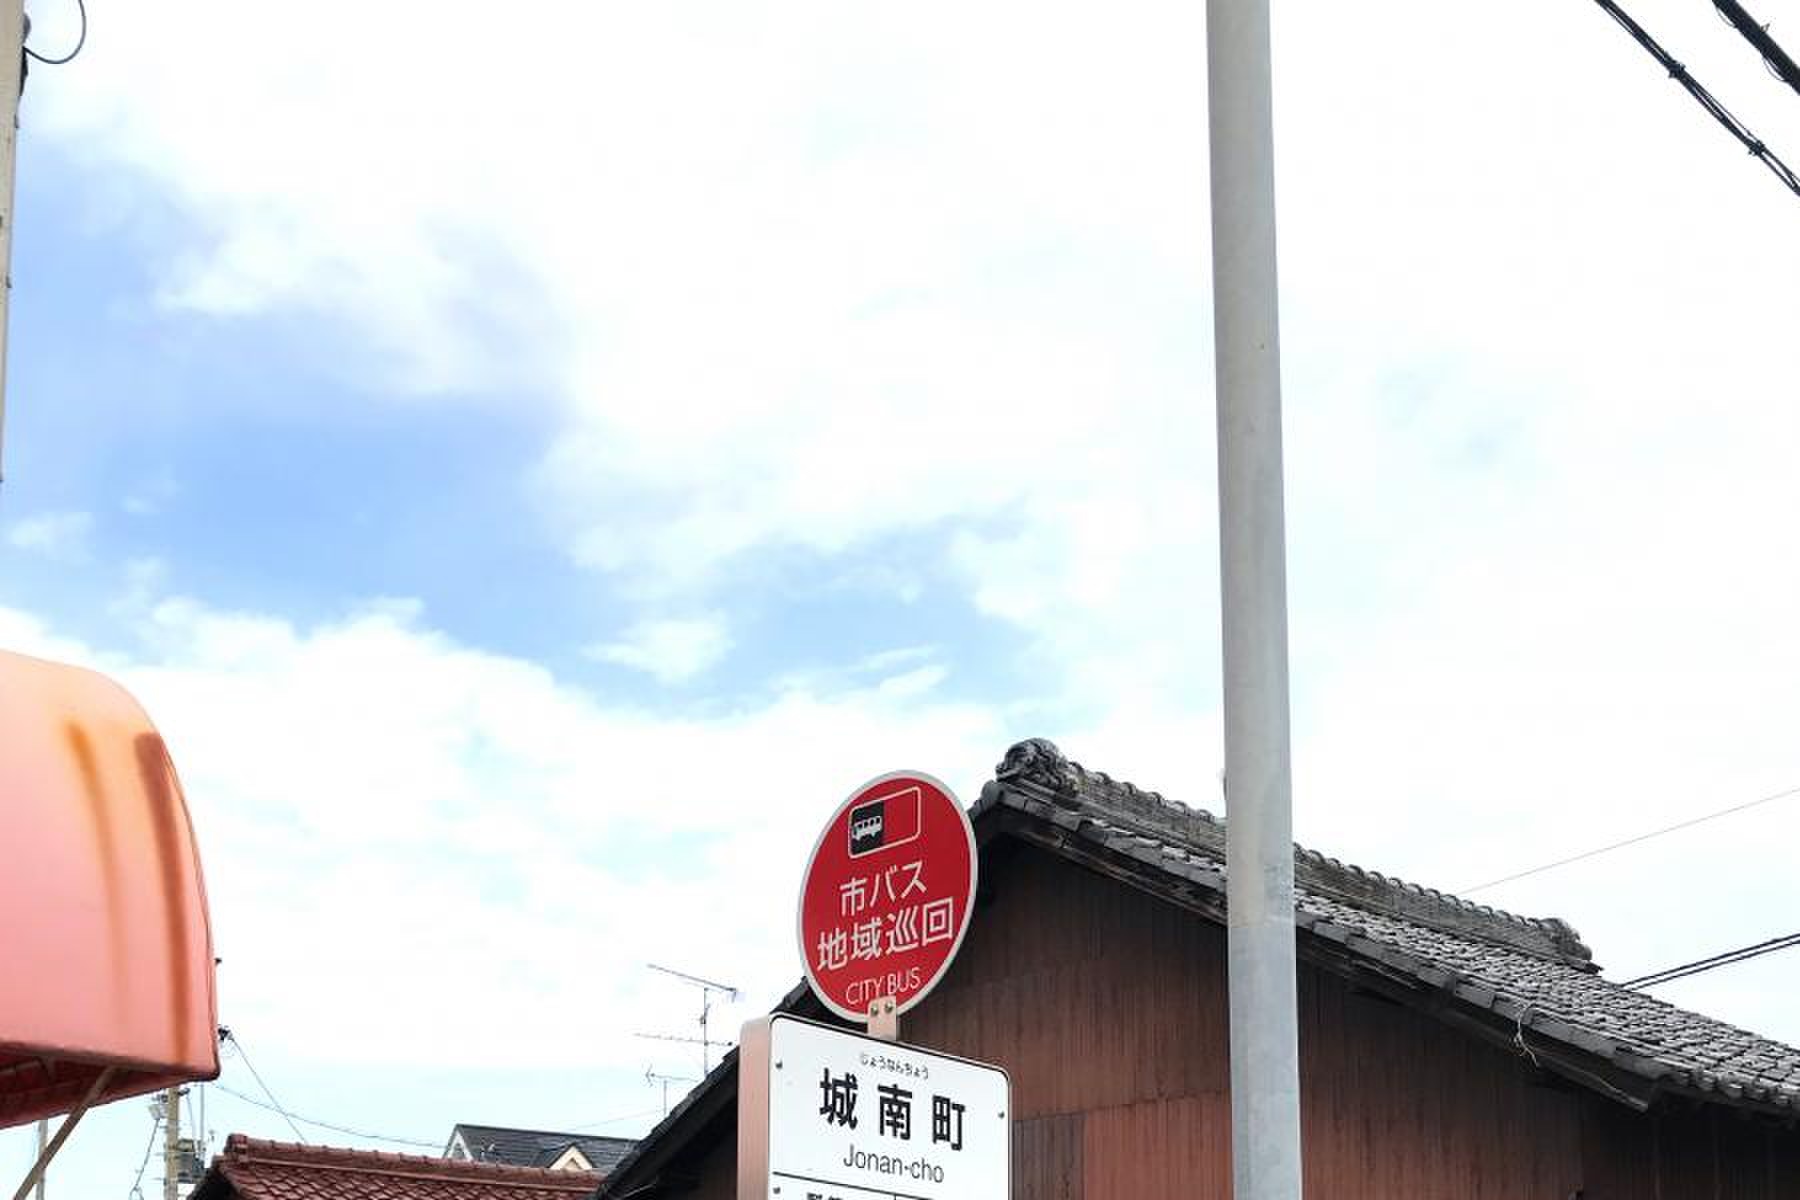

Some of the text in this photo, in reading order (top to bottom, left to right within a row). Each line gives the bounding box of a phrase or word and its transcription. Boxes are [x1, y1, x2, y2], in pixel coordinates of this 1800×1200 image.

[839, 860, 927, 917] 市バス
[816, 896, 954, 971] 地域巡回
[845, 966, 921, 1005] CITY BUS
[819, 1067, 966, 1151] 城南町
[843, 1144, 945, 1184] Jonan-cho
